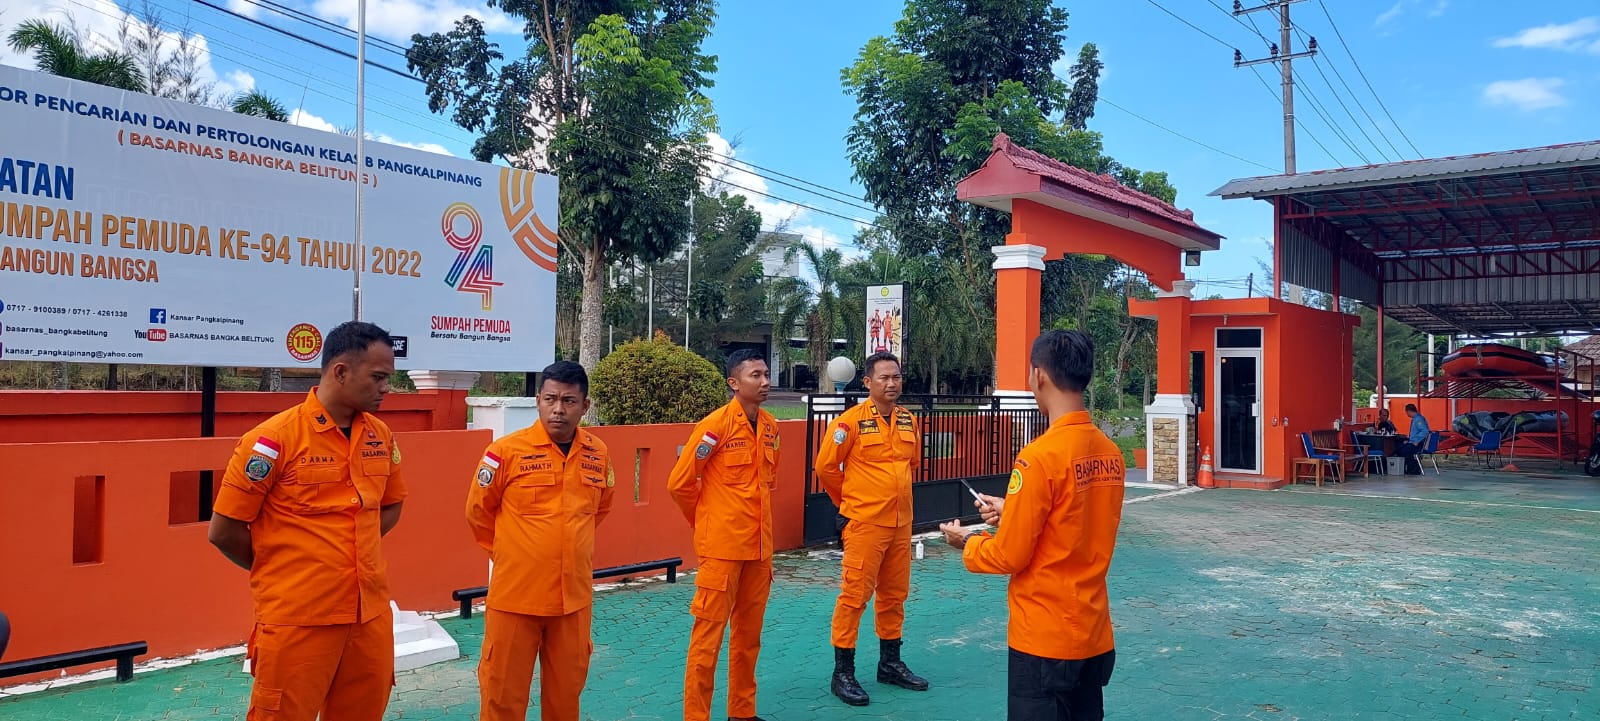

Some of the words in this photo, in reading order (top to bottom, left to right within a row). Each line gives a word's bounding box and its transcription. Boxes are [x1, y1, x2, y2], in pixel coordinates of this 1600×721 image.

[35, 94, 147, 126] PENCARIAN
[152, 116, 191, 134] DAN
[196, 125, 315, 156] PERTOLONGAN
[365, 156, 374, 168] B
[378, 158, 482, 187] PANGKALPINANG
[130, 132, 223, 160] BASARNAS
[228, 149, 295, 172] BANGKA
[102, 214, 212, 256] PEMUDA
[219, 228, 291, 264] KE-94
[371, 246, 421, 277] 2022
[0, 246, 74, 276] ANGUN
[80, 253, 159, 283] BANGSA
[6, 304, 26, 312] 0717
[72, 307, 91, 316] 0717
[431, 315, 471, 331] SUMPAH
[473, 318, 511, 334] PEMUDA
[169, 332, 209, 340] BASARNAS
[241, 335, 275, 343] BELITUNG
[294, 335, 314, 349] 115
[430, 331, 458, 339] Bersatu
[459, 333, 485, 341] Bangun
[486, 334, 511, 342] Bangsa
